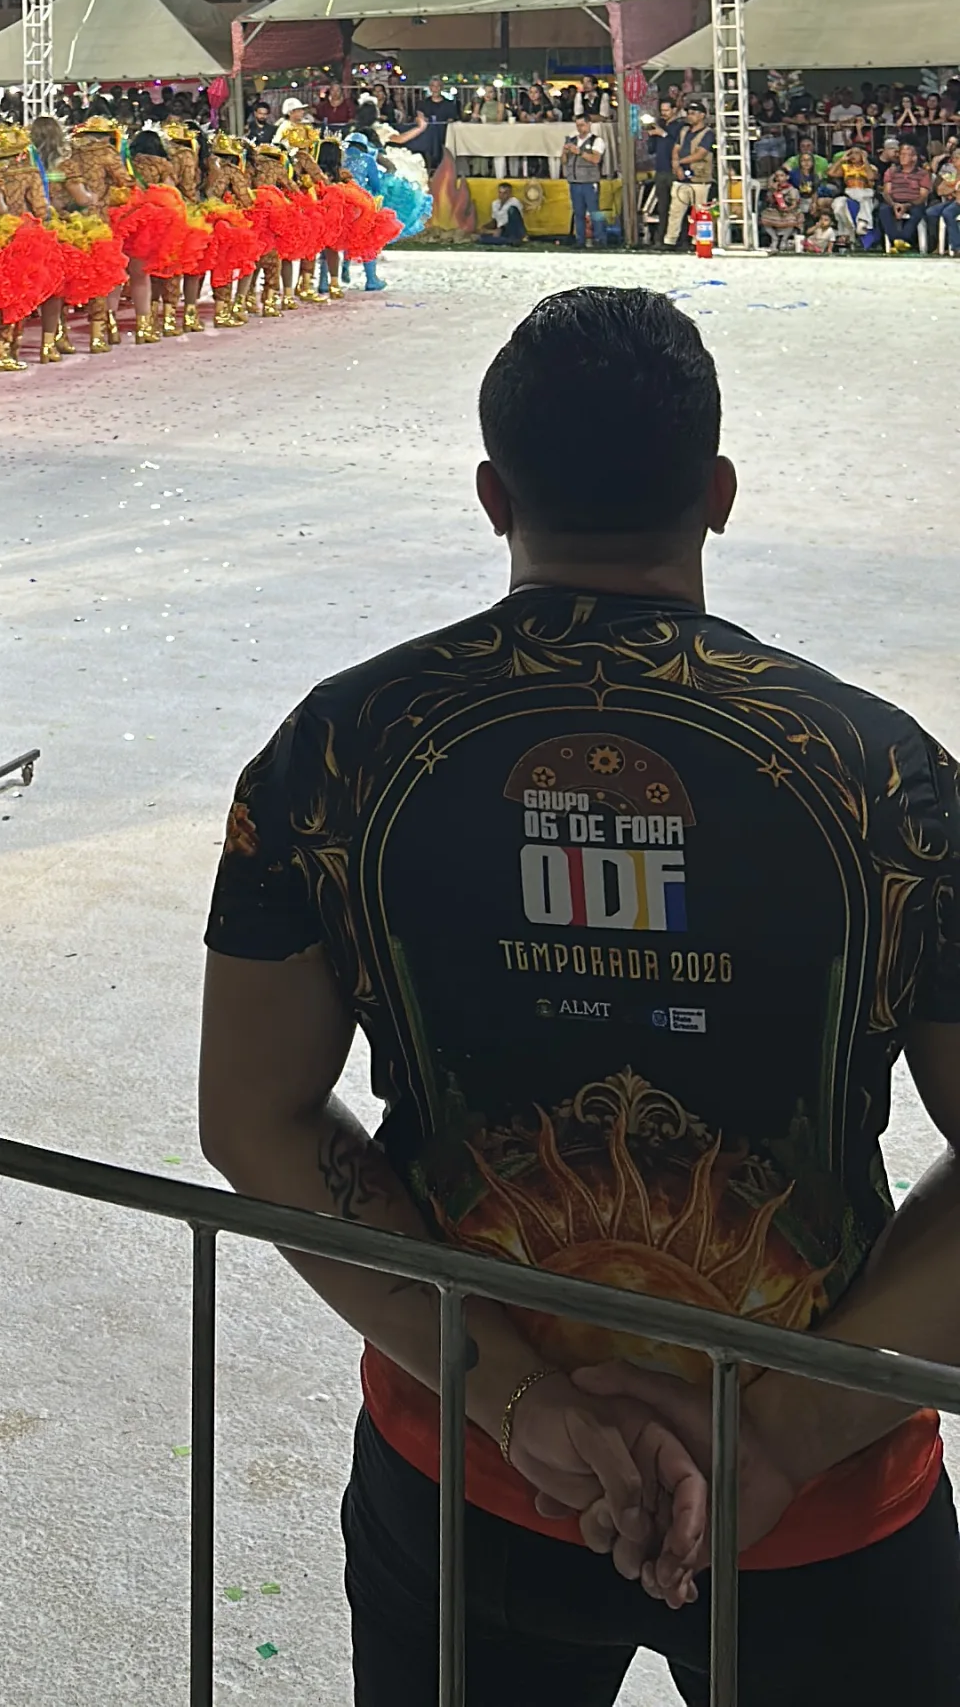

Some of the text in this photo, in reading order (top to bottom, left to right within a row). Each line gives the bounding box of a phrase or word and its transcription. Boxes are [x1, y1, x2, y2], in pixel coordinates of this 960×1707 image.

[523, 789, 590, 812] GRUPO
[523, 810, 685, 845] OS DE FORA
[519, 843, 687, 932] ODF
[498, 939, 734, 984] TEMPORADA 2026
[559, 999, 612, 1017] ALMT
